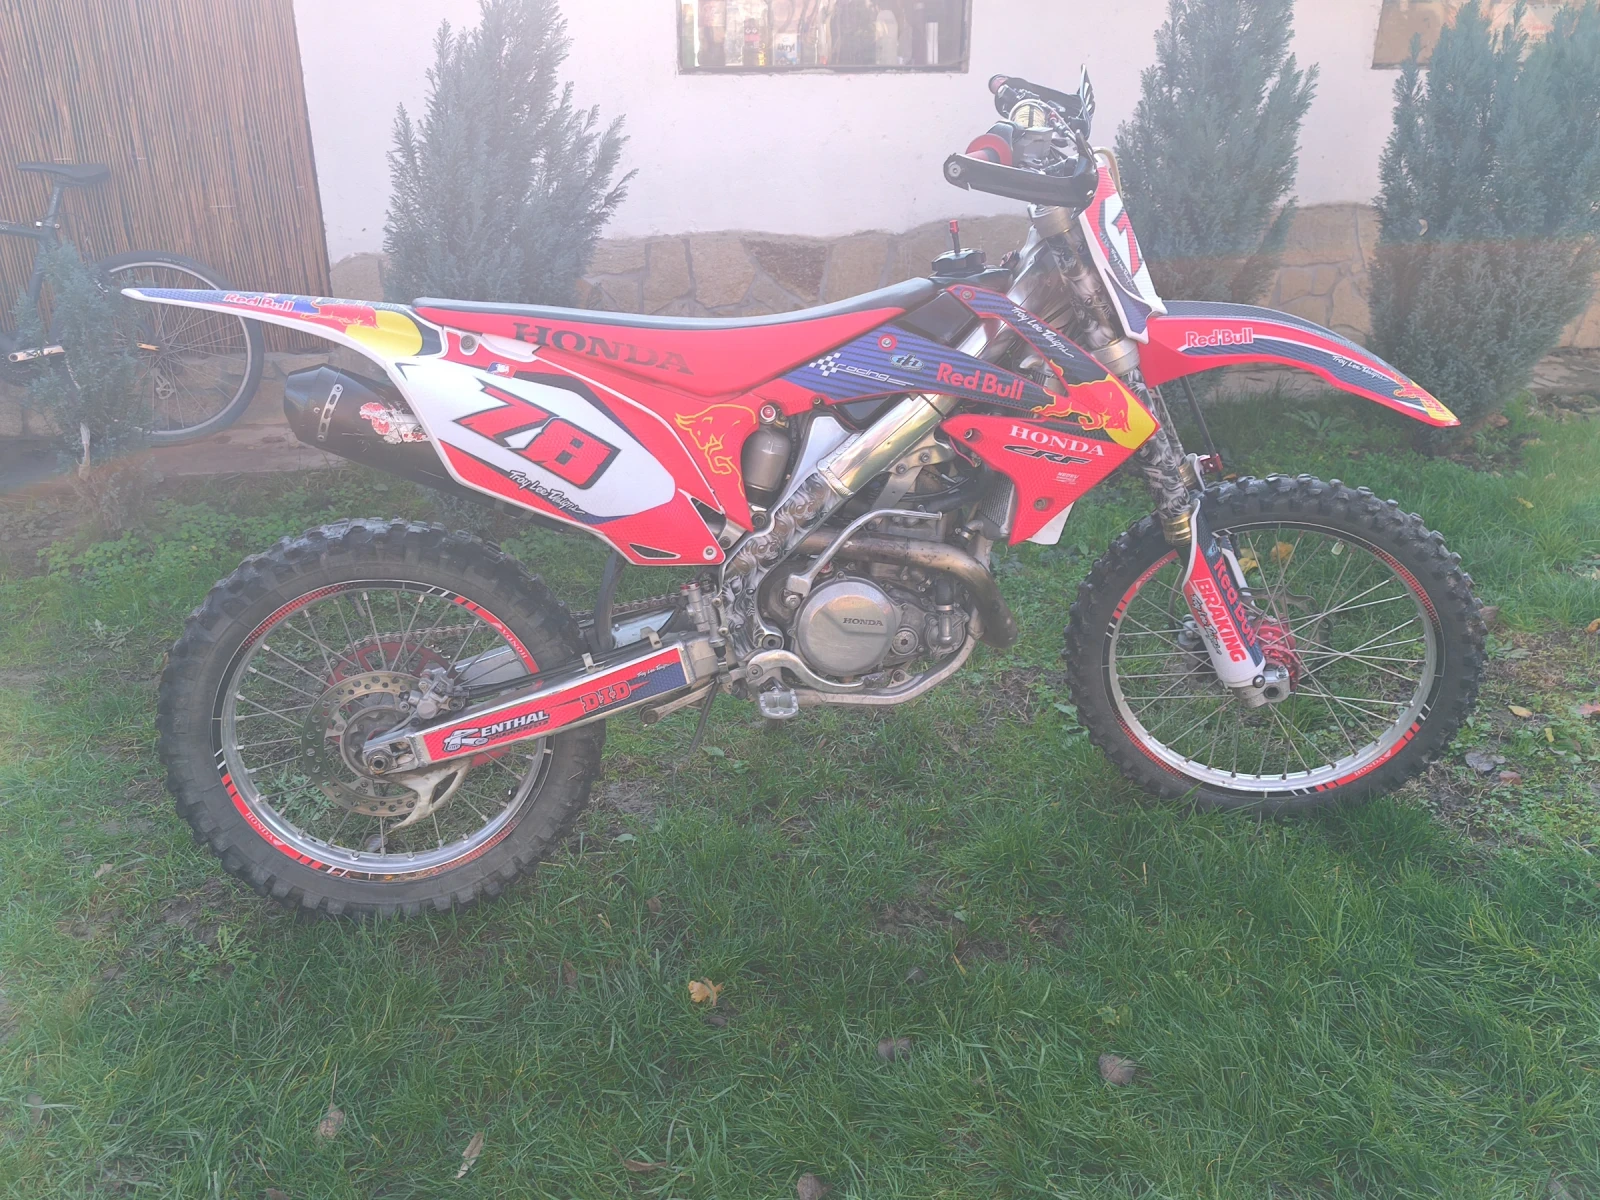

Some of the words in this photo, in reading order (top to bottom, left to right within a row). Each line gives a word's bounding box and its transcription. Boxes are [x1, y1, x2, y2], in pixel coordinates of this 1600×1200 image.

[224, 293, 260, 306] Red
[258, 297, 295, 312] Bull
[1011, 306, 1029, 321] Troy
[1027, 319, 1043, 333] Lee
[512, 322, 694, 376] HONDA
[1185, 328, 1219, 348] Red
[1220, 326, 1254, 346] Bull
[1331, 355, 1348, 367] Troy
[1347, 361, 1362, 371] Lee
[936, 362, 981, 391] Red
[981, 373, 1025, 401] Bull
[1008, 424, 1105, 456] HONDA
[1002, 444, 1093, 465] CRF
[508, 469, 532, 490] Troy
[529, 479, 549, 496] Lee
[842, 617, 884, 627] HONDA
[1198, 578, 1247, 663] BRAKING
